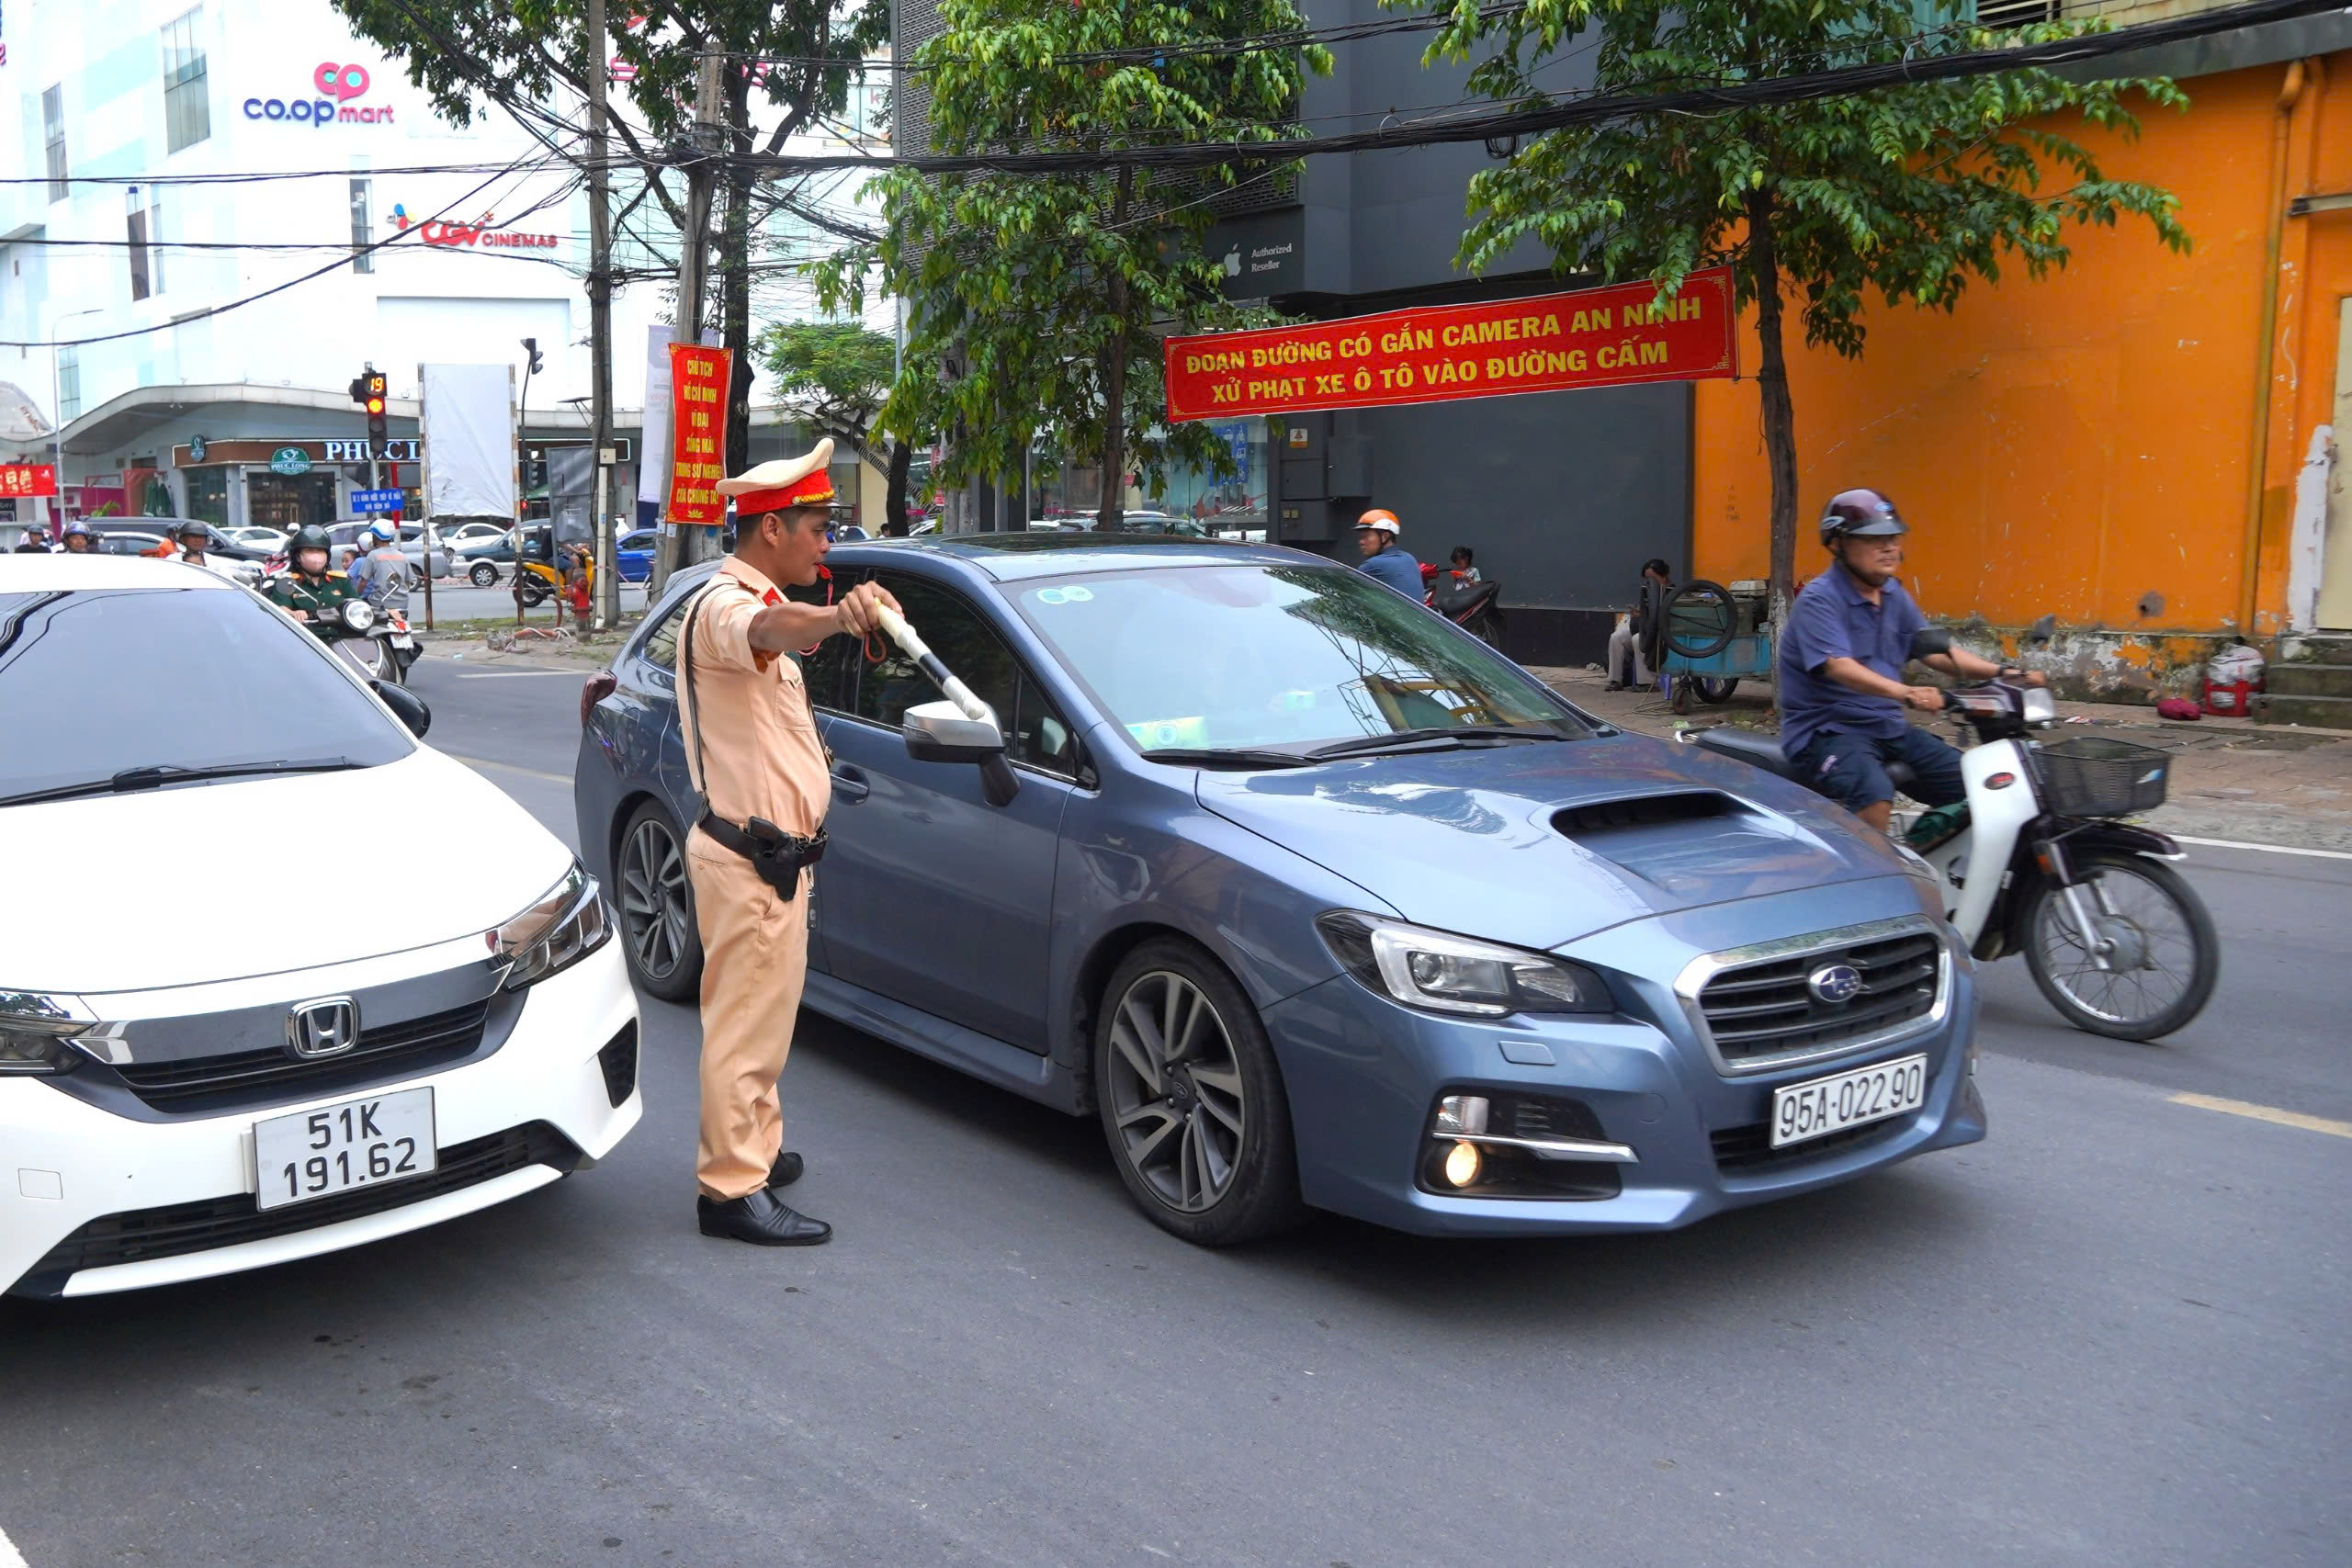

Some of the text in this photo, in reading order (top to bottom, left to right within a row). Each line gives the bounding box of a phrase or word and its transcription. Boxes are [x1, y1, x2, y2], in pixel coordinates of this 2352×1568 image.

[421, 220, 559, 248] CGV CINEMAS
[1251, 243, 1293, 259] Authorized
[1251, 260, 1281, 273] Reseller
[1186, 350, 1245, 375] ĐOẠN
[1252, 340, 1332, 367] ĐƯỜNG
[1339, 331, 1373, 358] CÓ
[1381, 321, 1434, 355] GẮN
[1442, 314, 1561, 346] CAMERA
[1570, 307, 1611, 333] AN
[370, 377, 383, 393] 19
[1212, 333, 1668, 403] XỬ PHẠT XE Ô TÔ VÀO ĐƯỜNG CẤM
[308, 1101, 382, 1150] 51K
[284, 1136, 416, 1198] 191.62
